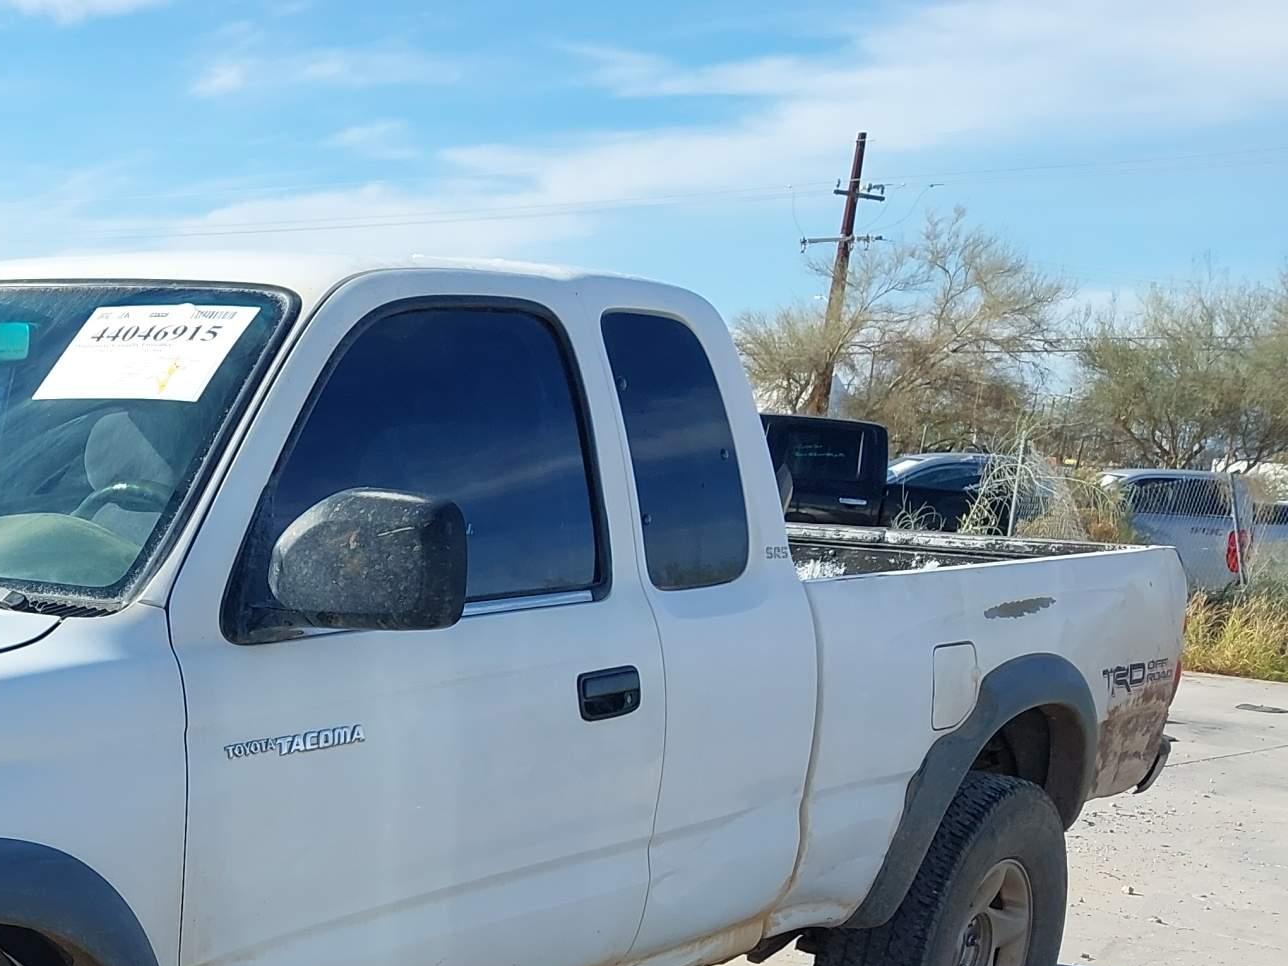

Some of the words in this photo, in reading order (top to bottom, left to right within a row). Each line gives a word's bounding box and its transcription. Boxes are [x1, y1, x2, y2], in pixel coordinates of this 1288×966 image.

[91, 325, 224, 342] 44046915
[1102, 662, 1146, 696] TRD
[223, 738, 277, 760] TOYOTA
[276, 724, 366, 756] TACOMA
